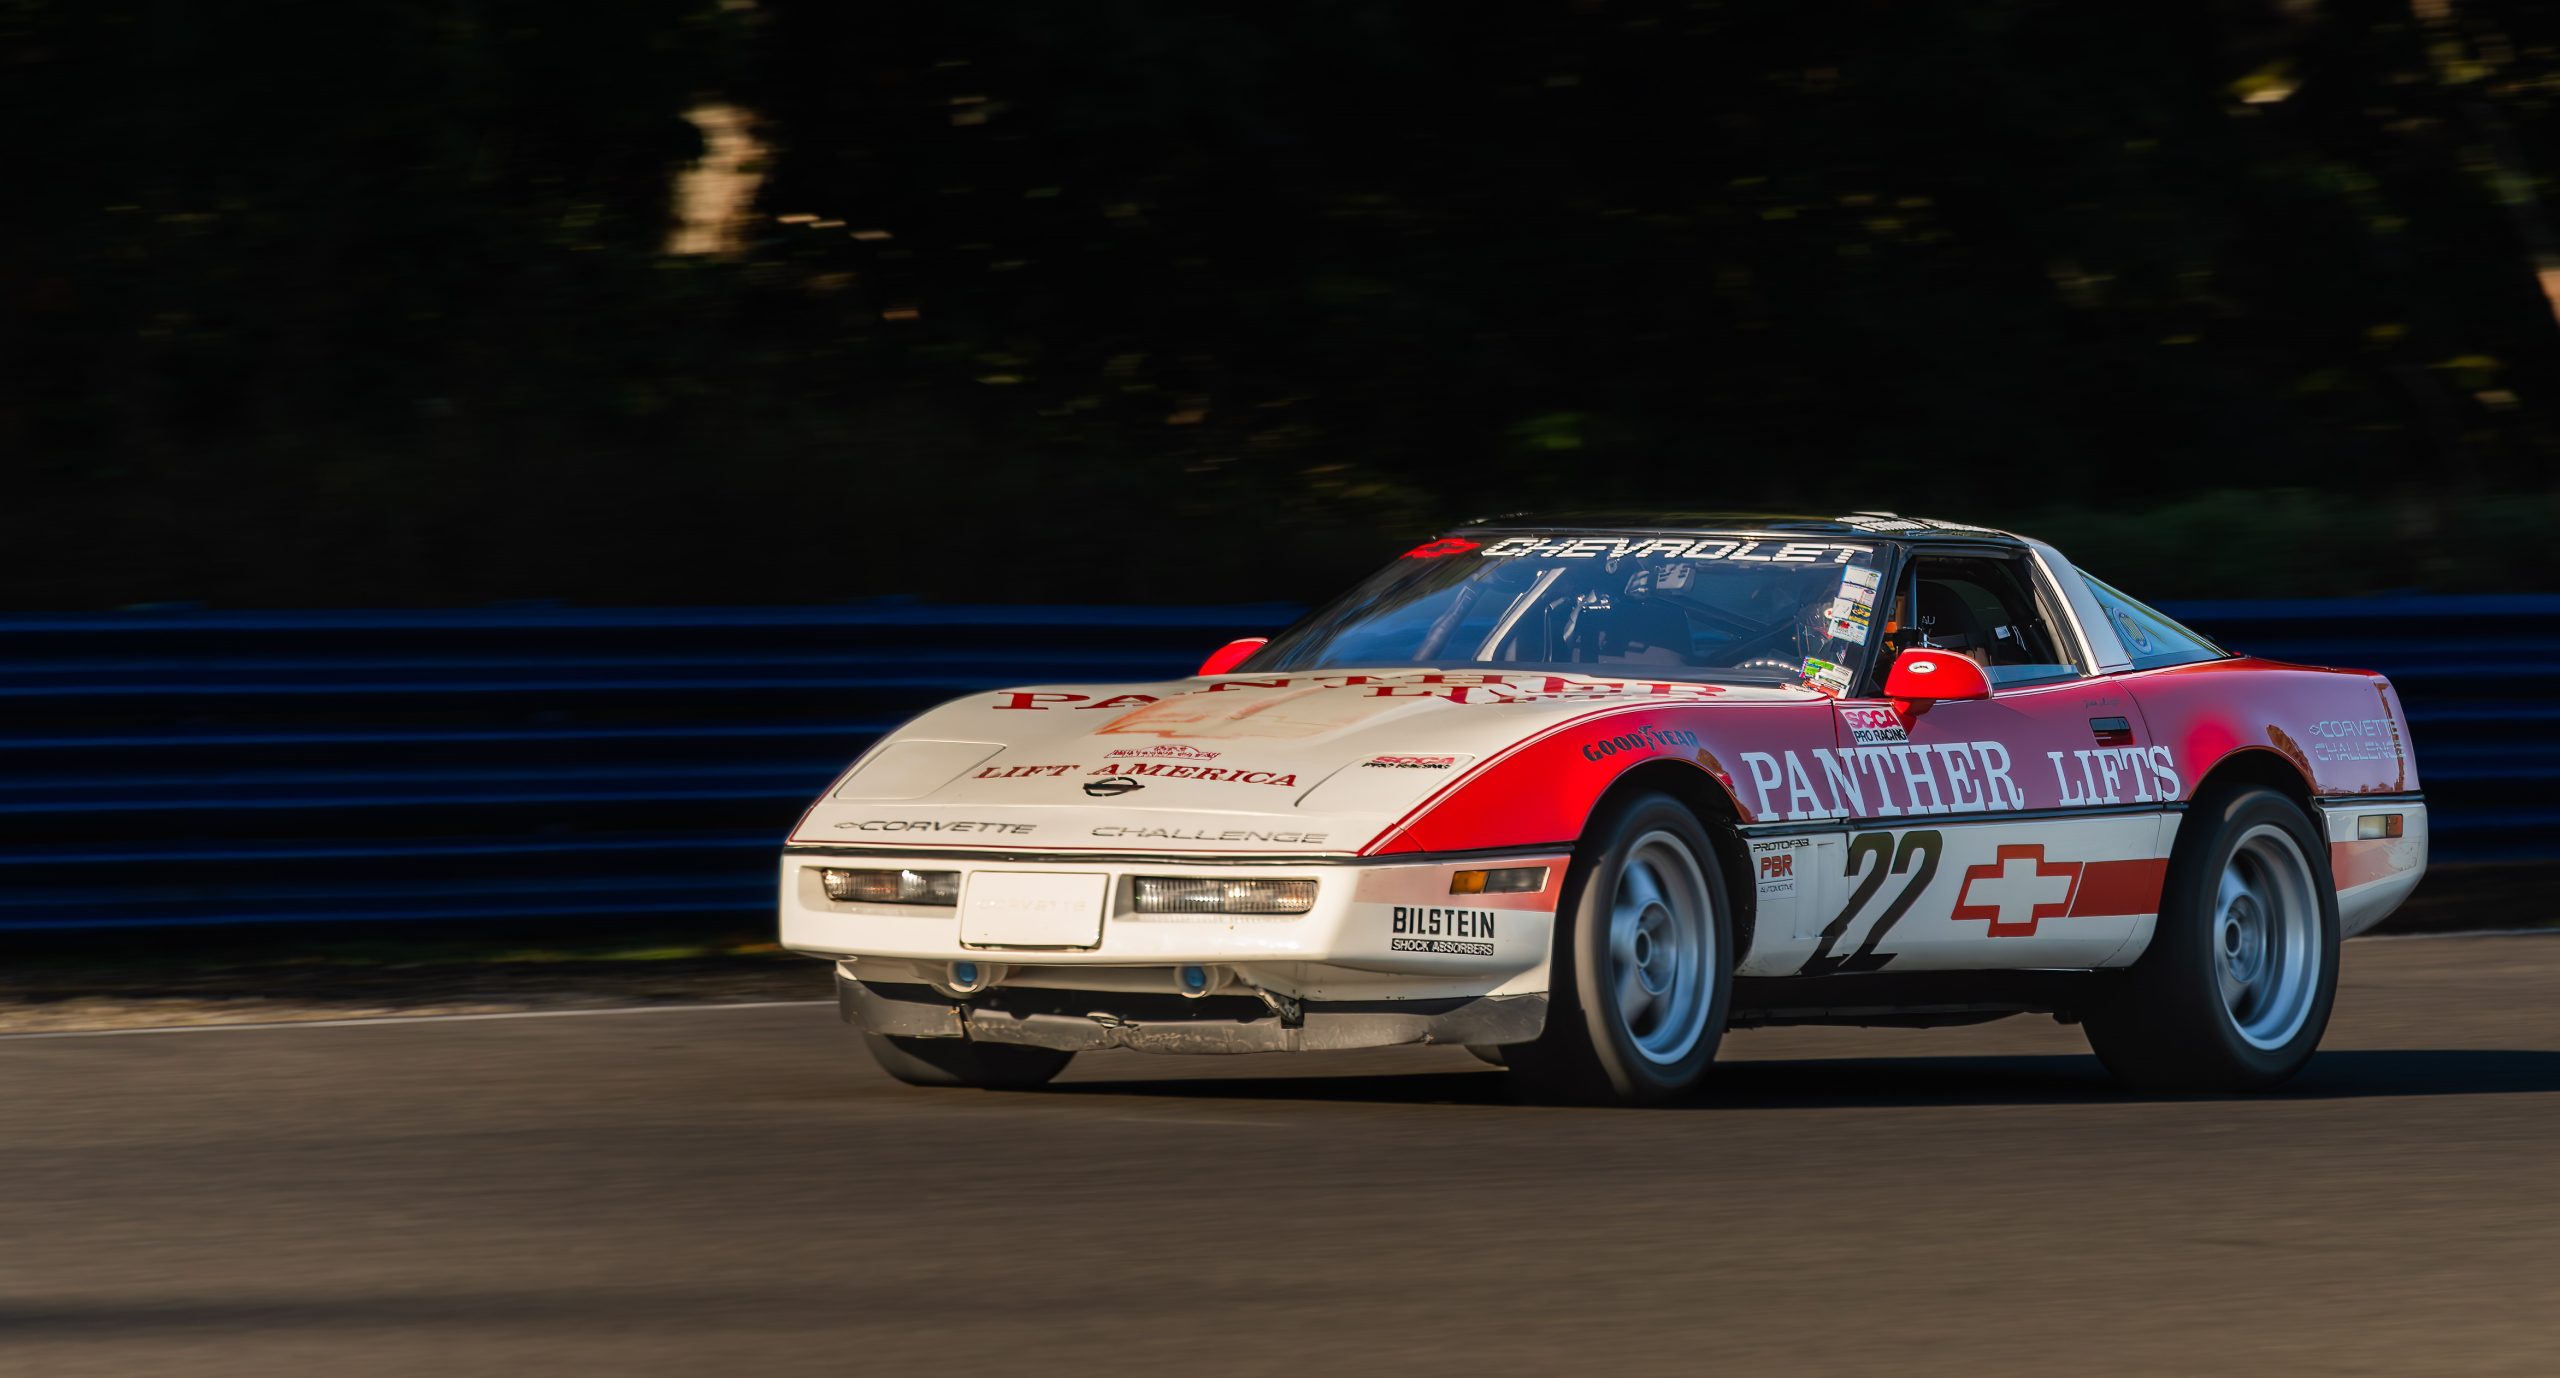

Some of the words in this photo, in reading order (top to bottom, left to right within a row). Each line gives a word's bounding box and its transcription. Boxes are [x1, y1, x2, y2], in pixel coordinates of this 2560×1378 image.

[1481, 537, 1873, 564] CHEVROLET
[1845, 710, 1901, 729] SCCA
[1854, 730, 1874, 743] PRO
[1873, 729, 1907, 742] RACING
[973, 764, 1081, 779] LIFT
[1087, 763, 1297, 787] AMERICA
[1740, 741, 2025, 822] PANTHER
[2047, 745, 2181, 806] LIFTS
[858, 821, 1037, 835] CORVETTE
[1092, 826, 1329, 844] CHALLENGE
[1761, 854, 1793, 879] PBR
[1800, 829, 1943, 976] 22
[1392, 906, 1495, 939] BILSTEIN
[1393, 939, 1430, 952] SHOCK
[1431, 941, 1494, 955] ABSORBERS
